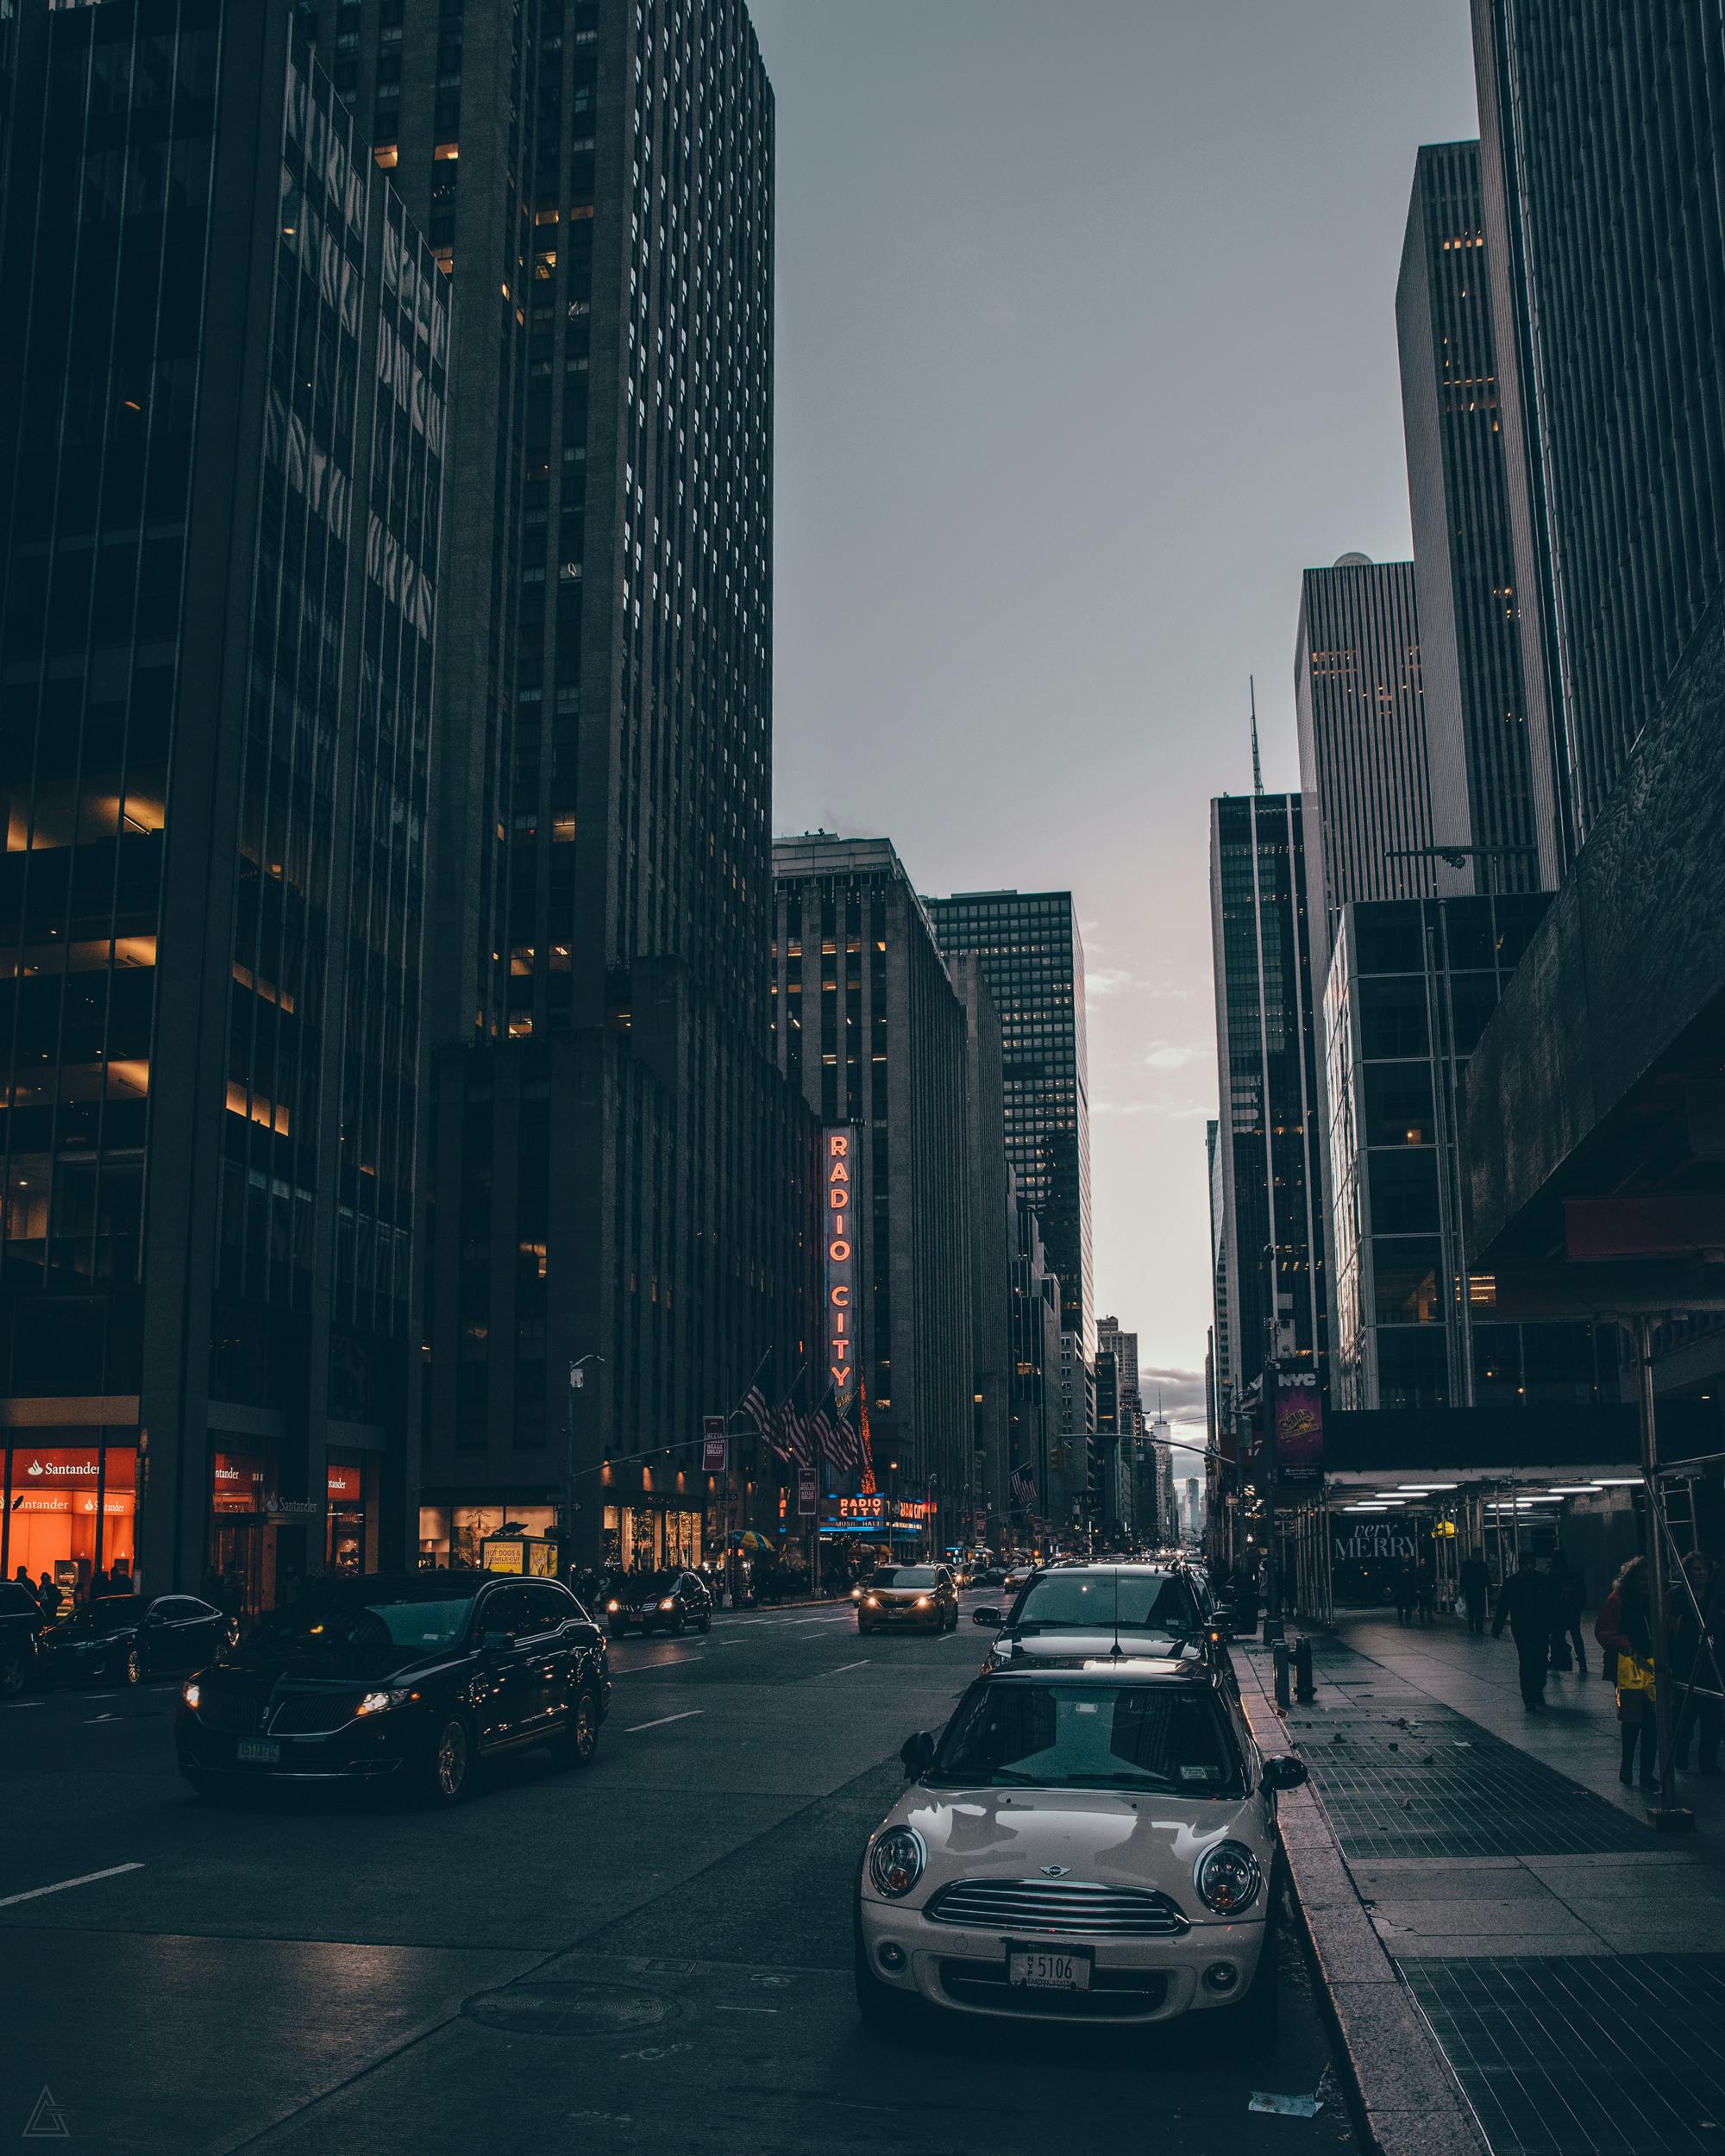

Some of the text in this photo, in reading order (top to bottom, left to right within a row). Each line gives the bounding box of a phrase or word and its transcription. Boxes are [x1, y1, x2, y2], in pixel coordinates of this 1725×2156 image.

[829, 1137, 850, 1387] RADIO CITY
[1277, 1373, 1317, 1387] NYC
[279, 1497, 317, 1513] Santander
[840, 1498, 881, 1507] RADIO
[840, 1507, 881, 1516] CITY
[1354, 1523, 1398, 1539] very
[1334, 1536, 1417, 1558] MERRY
[1038, 1956, 1072, 1979] 5106
